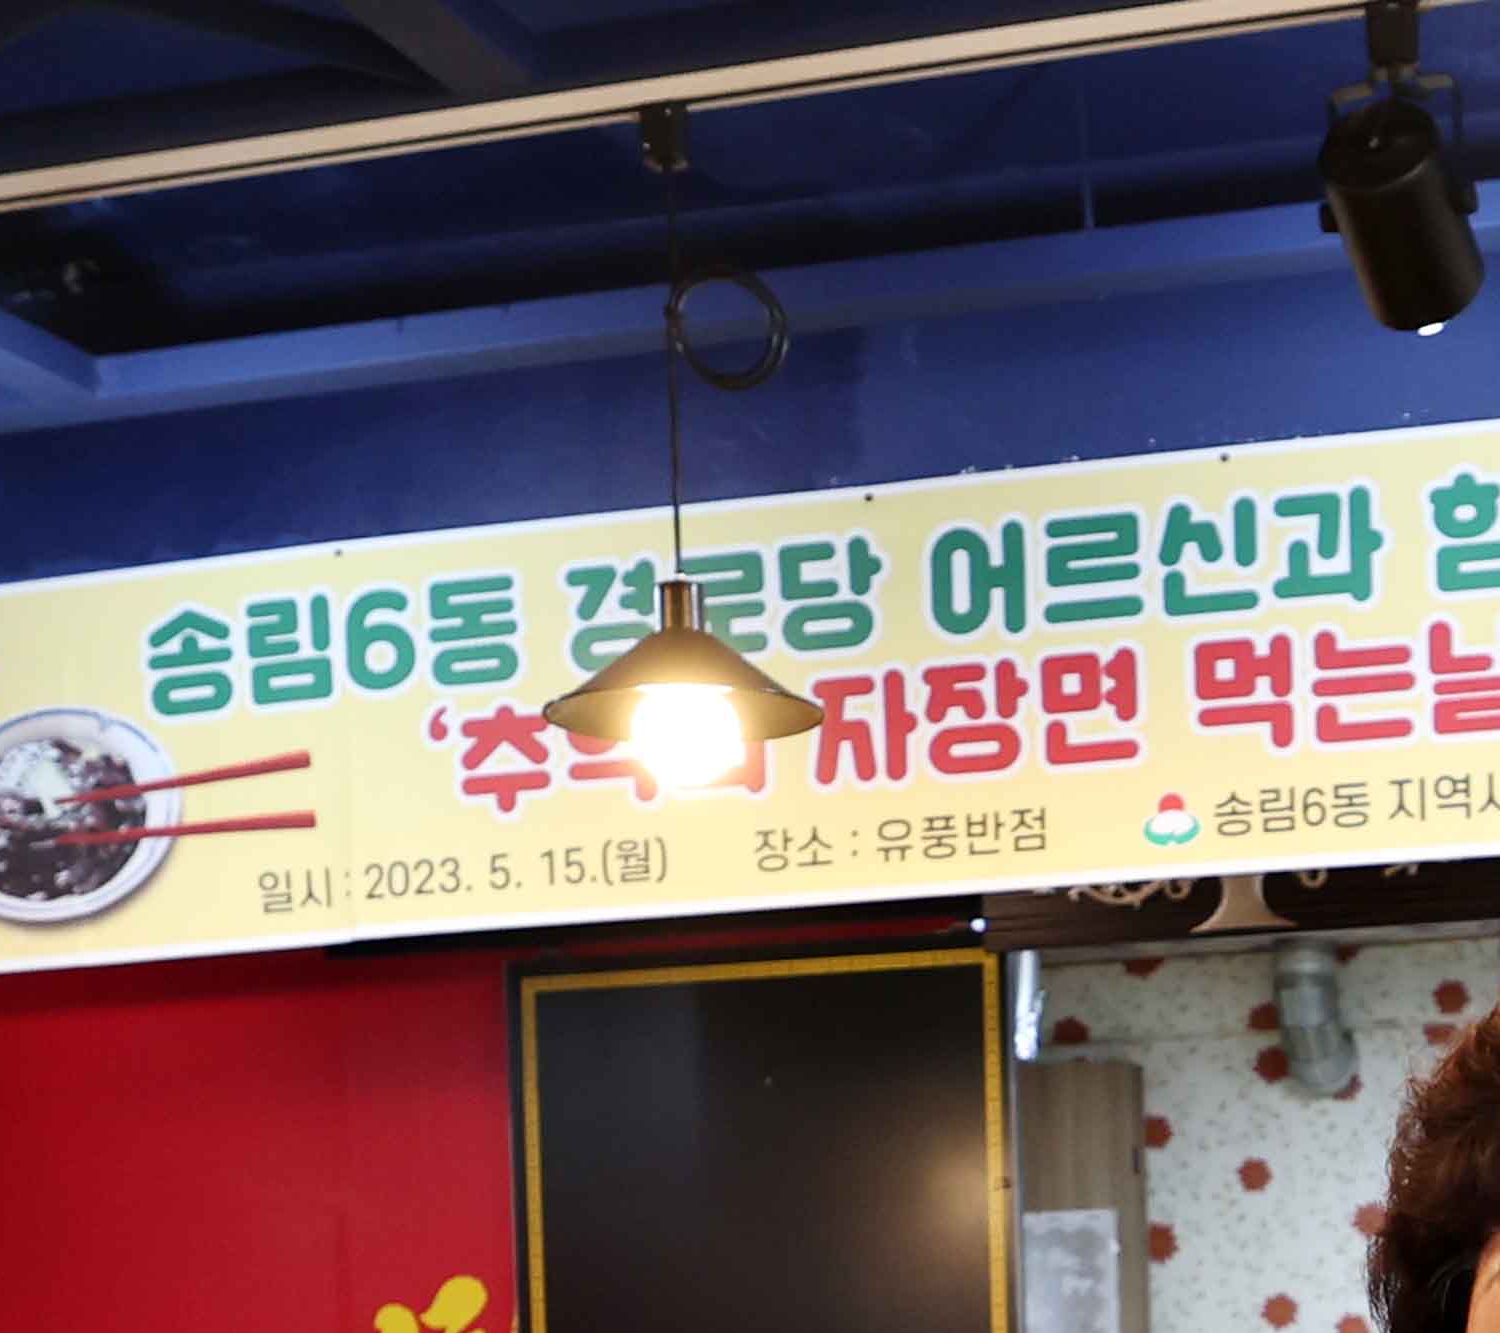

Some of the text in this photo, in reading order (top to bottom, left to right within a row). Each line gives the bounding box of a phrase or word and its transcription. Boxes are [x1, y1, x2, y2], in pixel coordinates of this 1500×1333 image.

[147, 575, 519, 716] 송림6동
[930, 485, 1383, 634] 어르신과
[812, 647, 1139, 785] 자장면
[876, 807, 1048, 863] 유풍반점
[1213, 781, 1372, 837] 송림6동
[364, 858, 473, 900] 2023.
[489, 853, 522, 891] 5.
